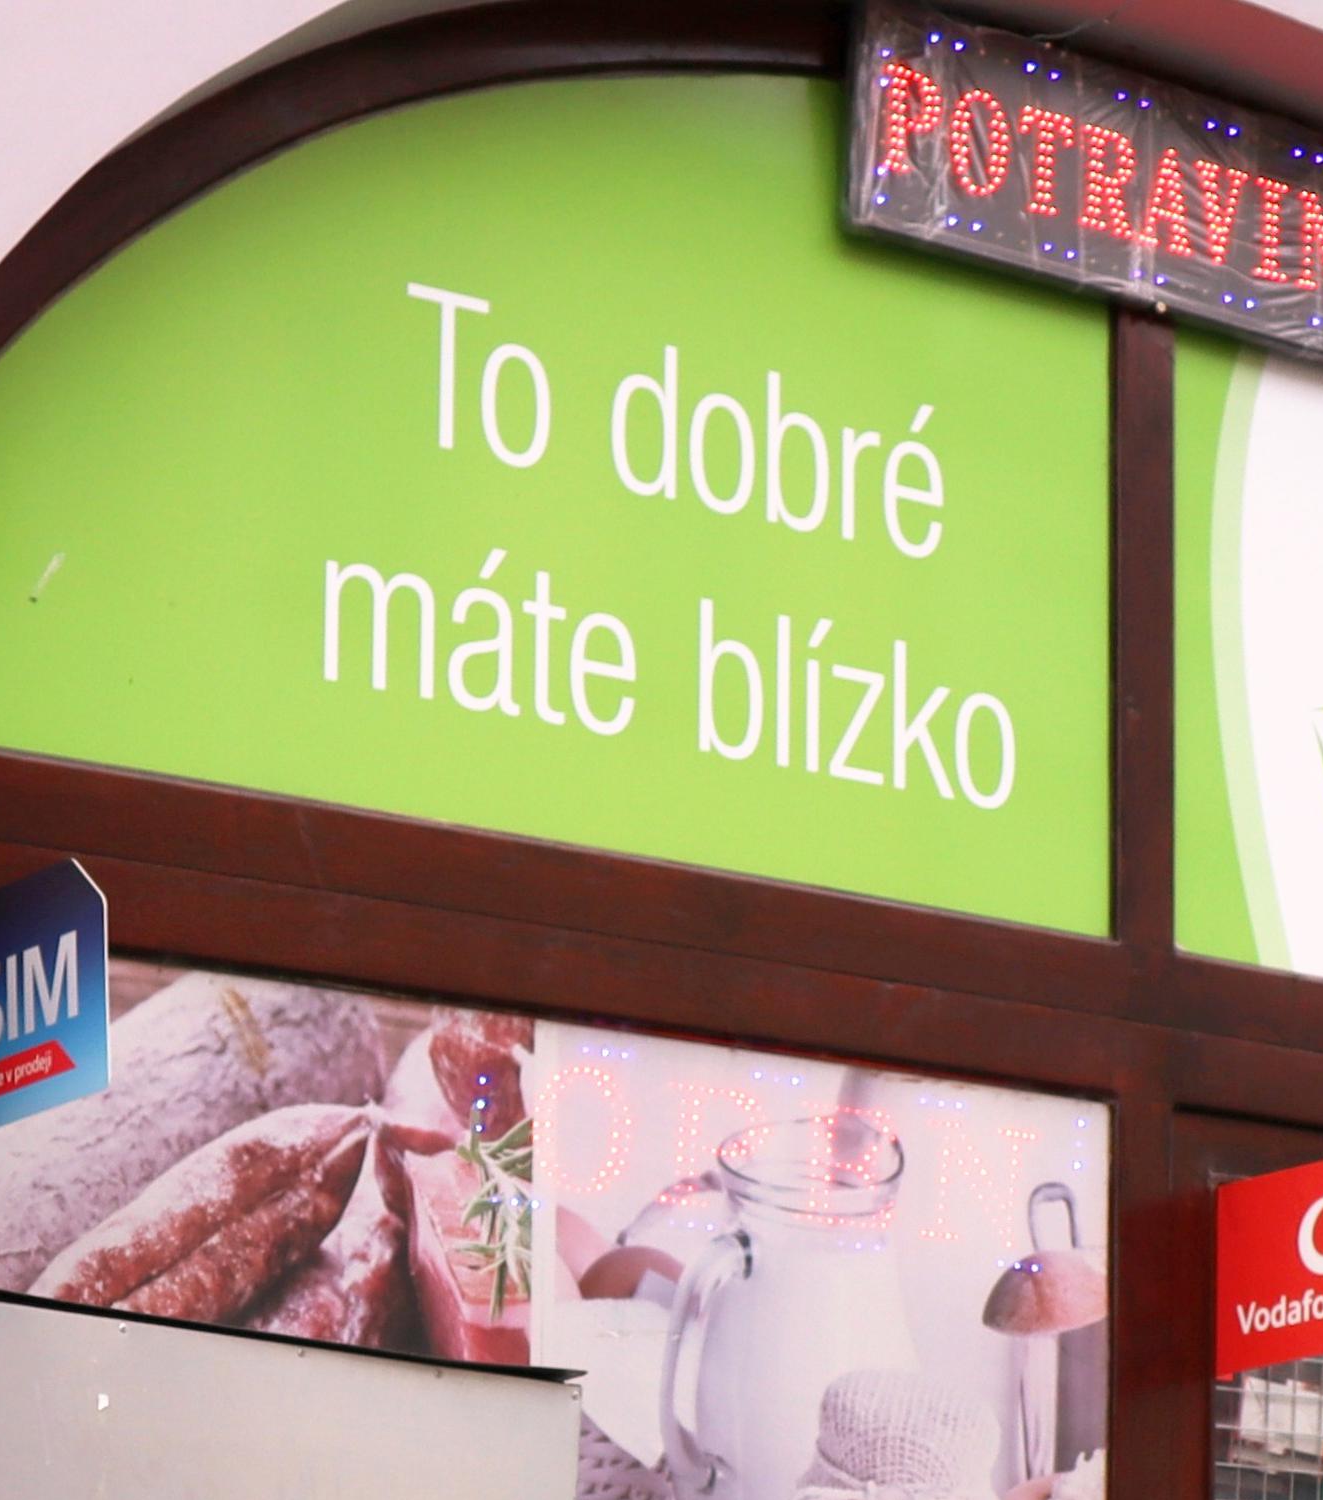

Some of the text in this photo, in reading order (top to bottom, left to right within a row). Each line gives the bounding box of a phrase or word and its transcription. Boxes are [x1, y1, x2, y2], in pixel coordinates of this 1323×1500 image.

[406, 281, 945, 560] To dobré
[323, 547, 1017, 810] máte blízko
[5, 1068, 14, 1083] v
[14, 1050, 53, 1085] prodeji
[531, 1064, 1038, 1249] OPEN
